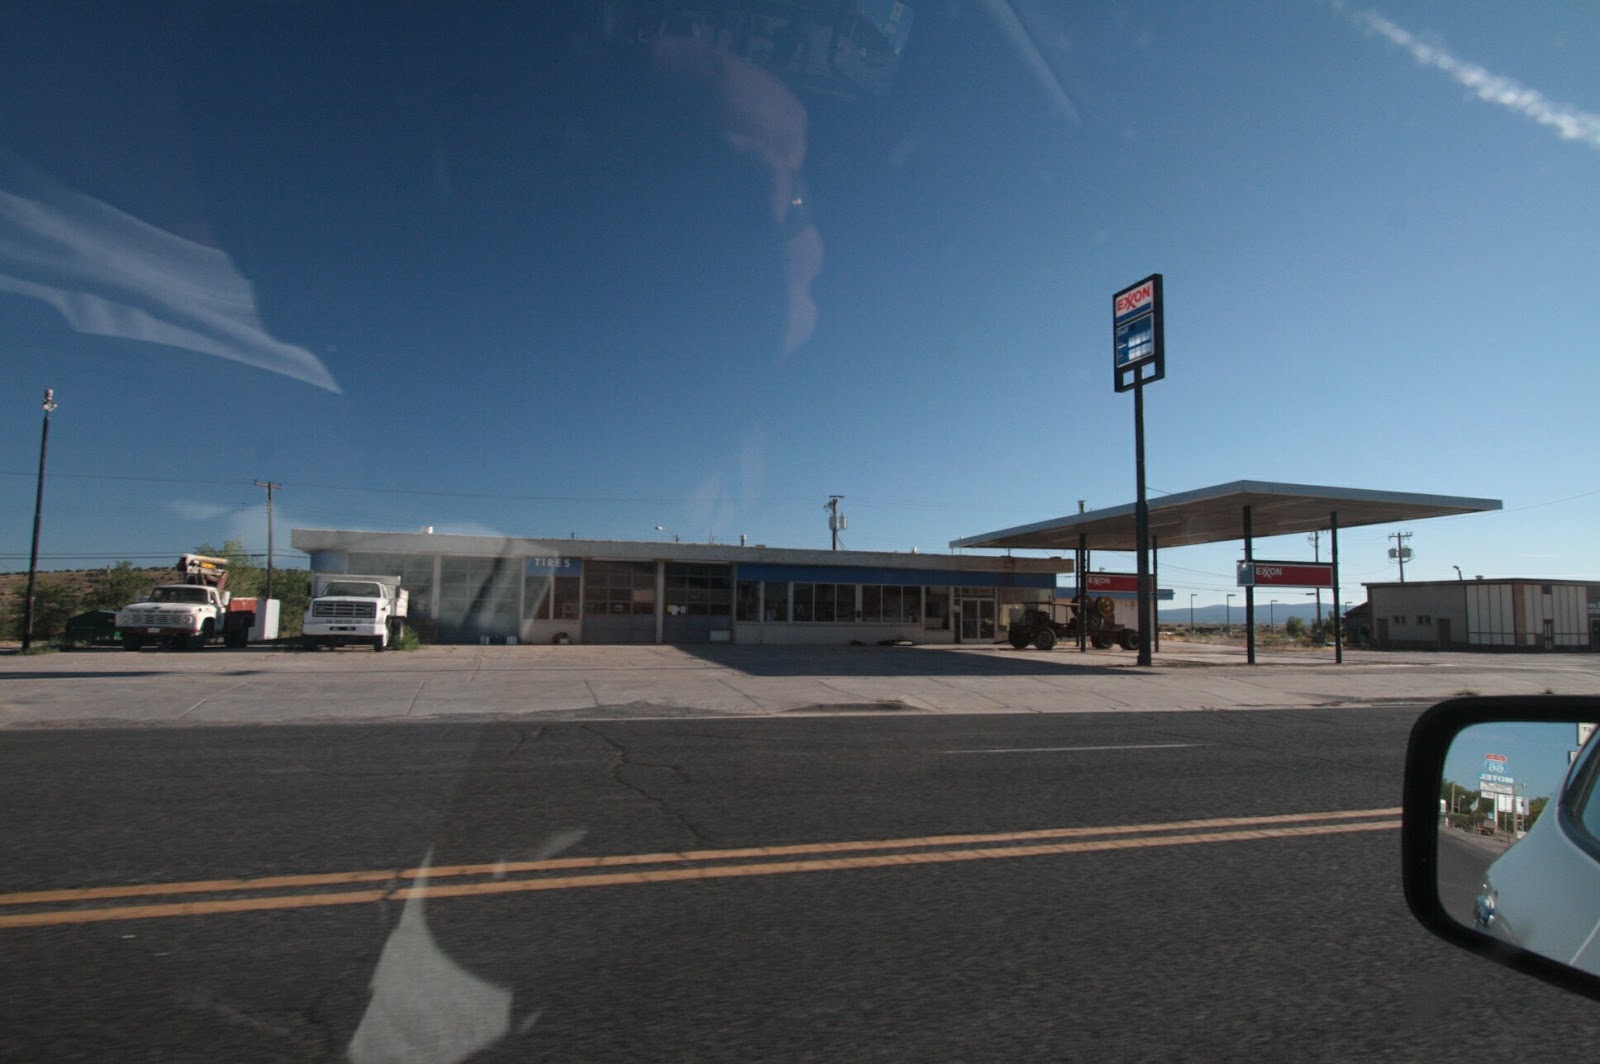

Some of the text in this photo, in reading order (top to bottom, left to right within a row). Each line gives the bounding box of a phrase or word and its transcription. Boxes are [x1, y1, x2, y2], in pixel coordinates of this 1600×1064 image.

[1117, 286, 1150, 311] EXXON
[535, 557, 571, 568] TIRES
[1256, 566, 1282, 578] EXXON
[1088, 576, 1111, 586] EXXON
